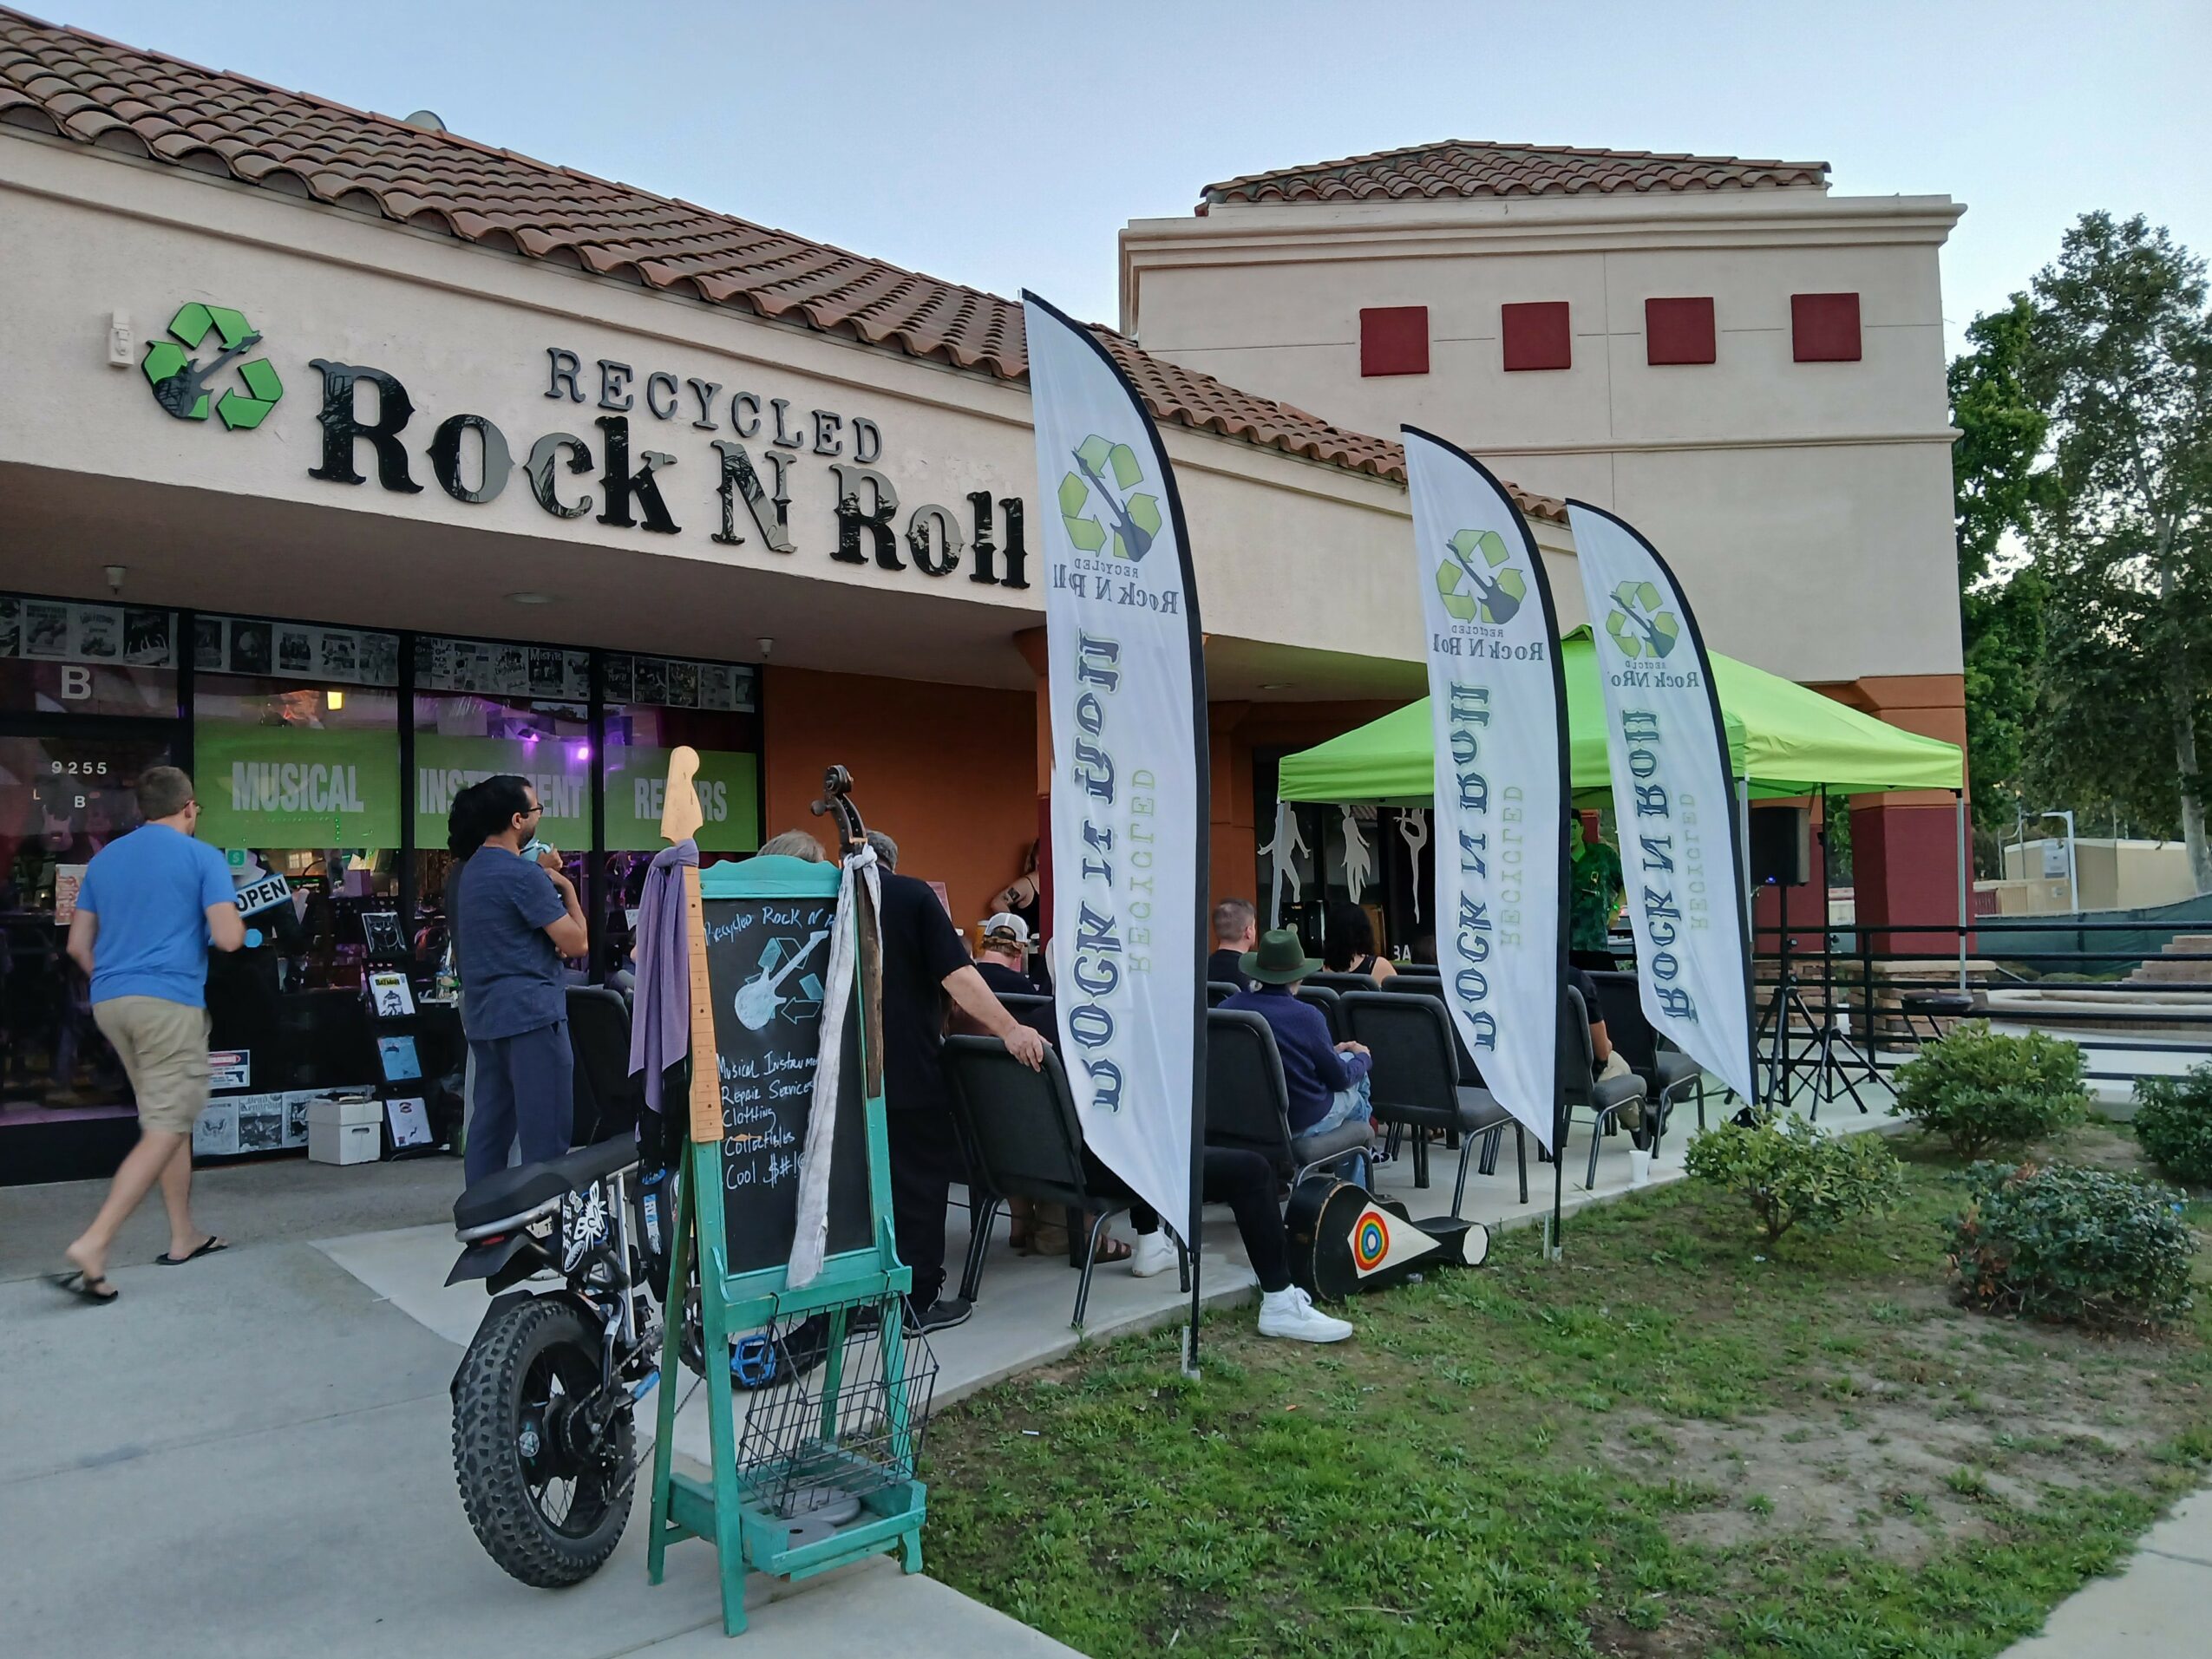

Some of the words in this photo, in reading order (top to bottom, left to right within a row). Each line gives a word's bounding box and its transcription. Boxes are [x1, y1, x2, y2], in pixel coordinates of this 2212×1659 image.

[545, 347, 882, 463] RECYCLED
[307, 357, 682, 534] Rock
[710, 440, 797, 553] N
[829, 463, 1031, 589] Roll
[62, 665, 91, 699] B
[51, 761, 107, 774] 9255
[232, 761, 364, 813] MUSICAL
[634, 778, 728, 822] RERS
[237, 878, 287, 911] OPEN
[808, 908, 823, 924] N
[727, 1159, 756, 1190] Cool
